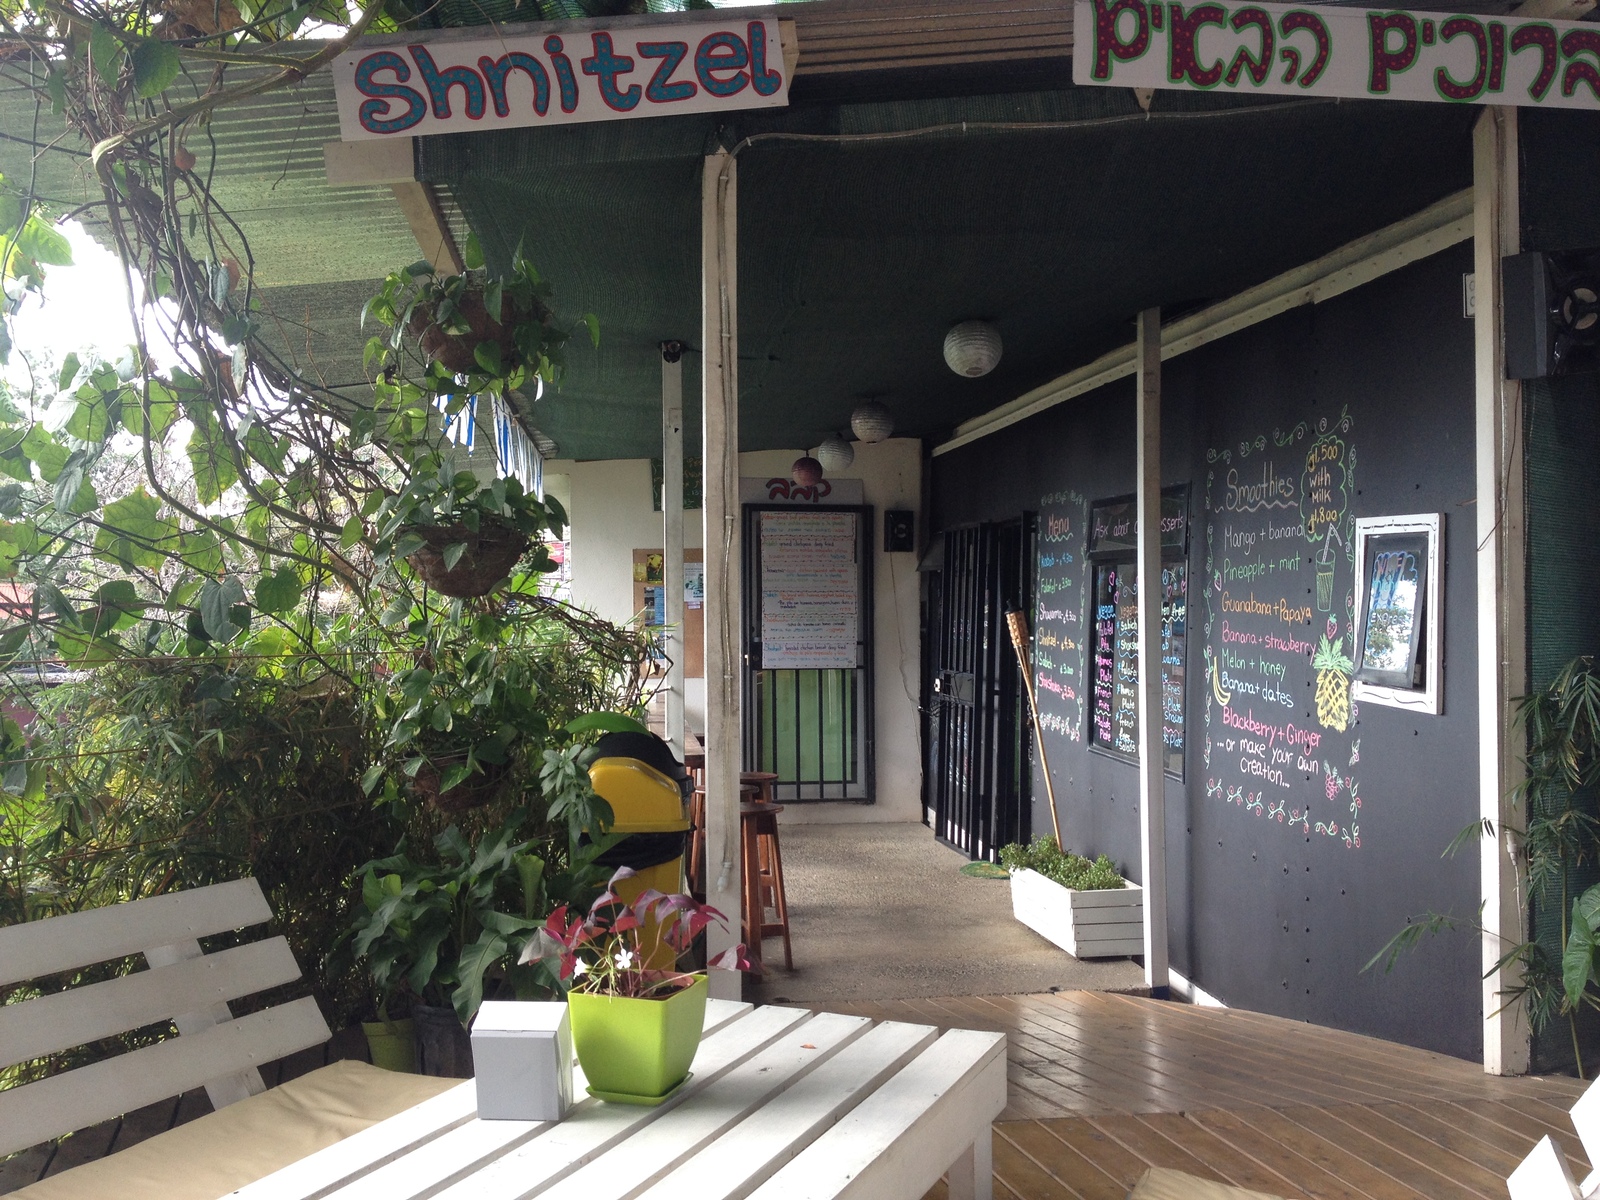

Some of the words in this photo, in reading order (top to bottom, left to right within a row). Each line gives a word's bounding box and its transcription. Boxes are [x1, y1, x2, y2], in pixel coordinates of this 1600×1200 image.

[1091, 0, 1332, 89] הבאים
[354, 21, 782, 134] Shnitzel
[1225, 461, 1295, 510] Smoothies
[1048, 514, 1070, 536] Menu
[1093, 517, 1109, 540] Ask
[1113, 518, 1130, 537] about
[1224, 526, 1257, 555] Mango
[1268, 521, 1304, 539] banana
[1224, 552, 1265, 583] Pineapple
[1279, 556, 1301, 572] mint
[1221, 592, 1272, 616] Guanabana
[1279, 598, 1312, 625] Papaya
[1221, 621, 1257, 646] Banana
[1264, 633, 1316, 666] strawberry
[1221, 648, 1246, 670] Melon
[1259, 661, 1287, 682] honey
[1221, 672, 1254, 694] Banana
[1262, 685, 1294, 708] dates
[1222, 705, 1277, 748] Blackberry
[1286, 724, 1322, 756] Ginger
[1240, 739, 1266, 758] make
[1271, 748, 1294, 765] your
[1297, 755, 1319, 775] own
